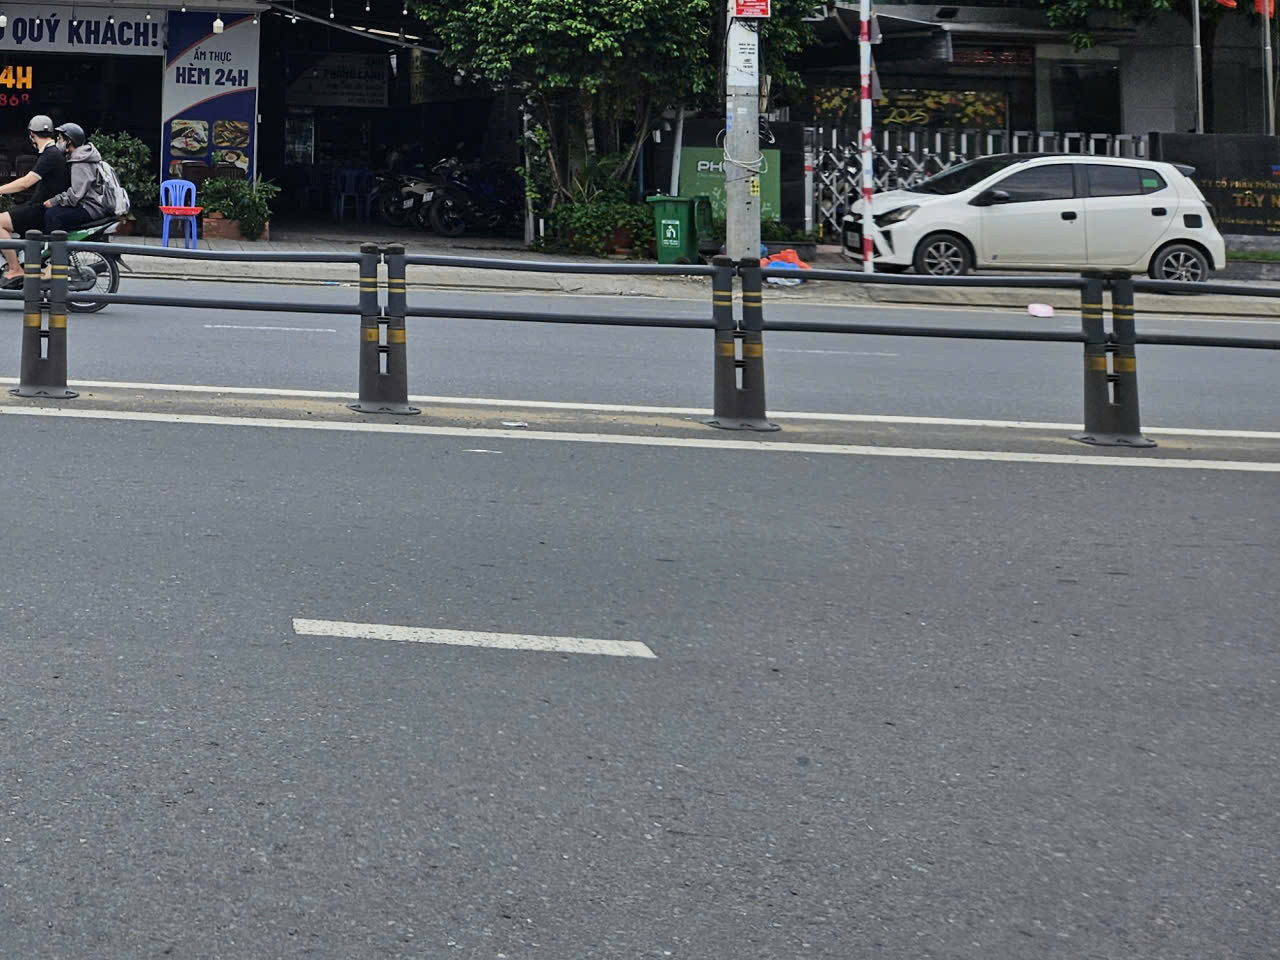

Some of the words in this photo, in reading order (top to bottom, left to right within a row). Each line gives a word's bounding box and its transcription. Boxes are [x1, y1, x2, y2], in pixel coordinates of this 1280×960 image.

[12, 12, 61, 44] QUÝ
[67, 14, 159, 47] KHÁCH!
[175, 62, 210, 85] HÈM
[214, 68, 249, 87] 24H
